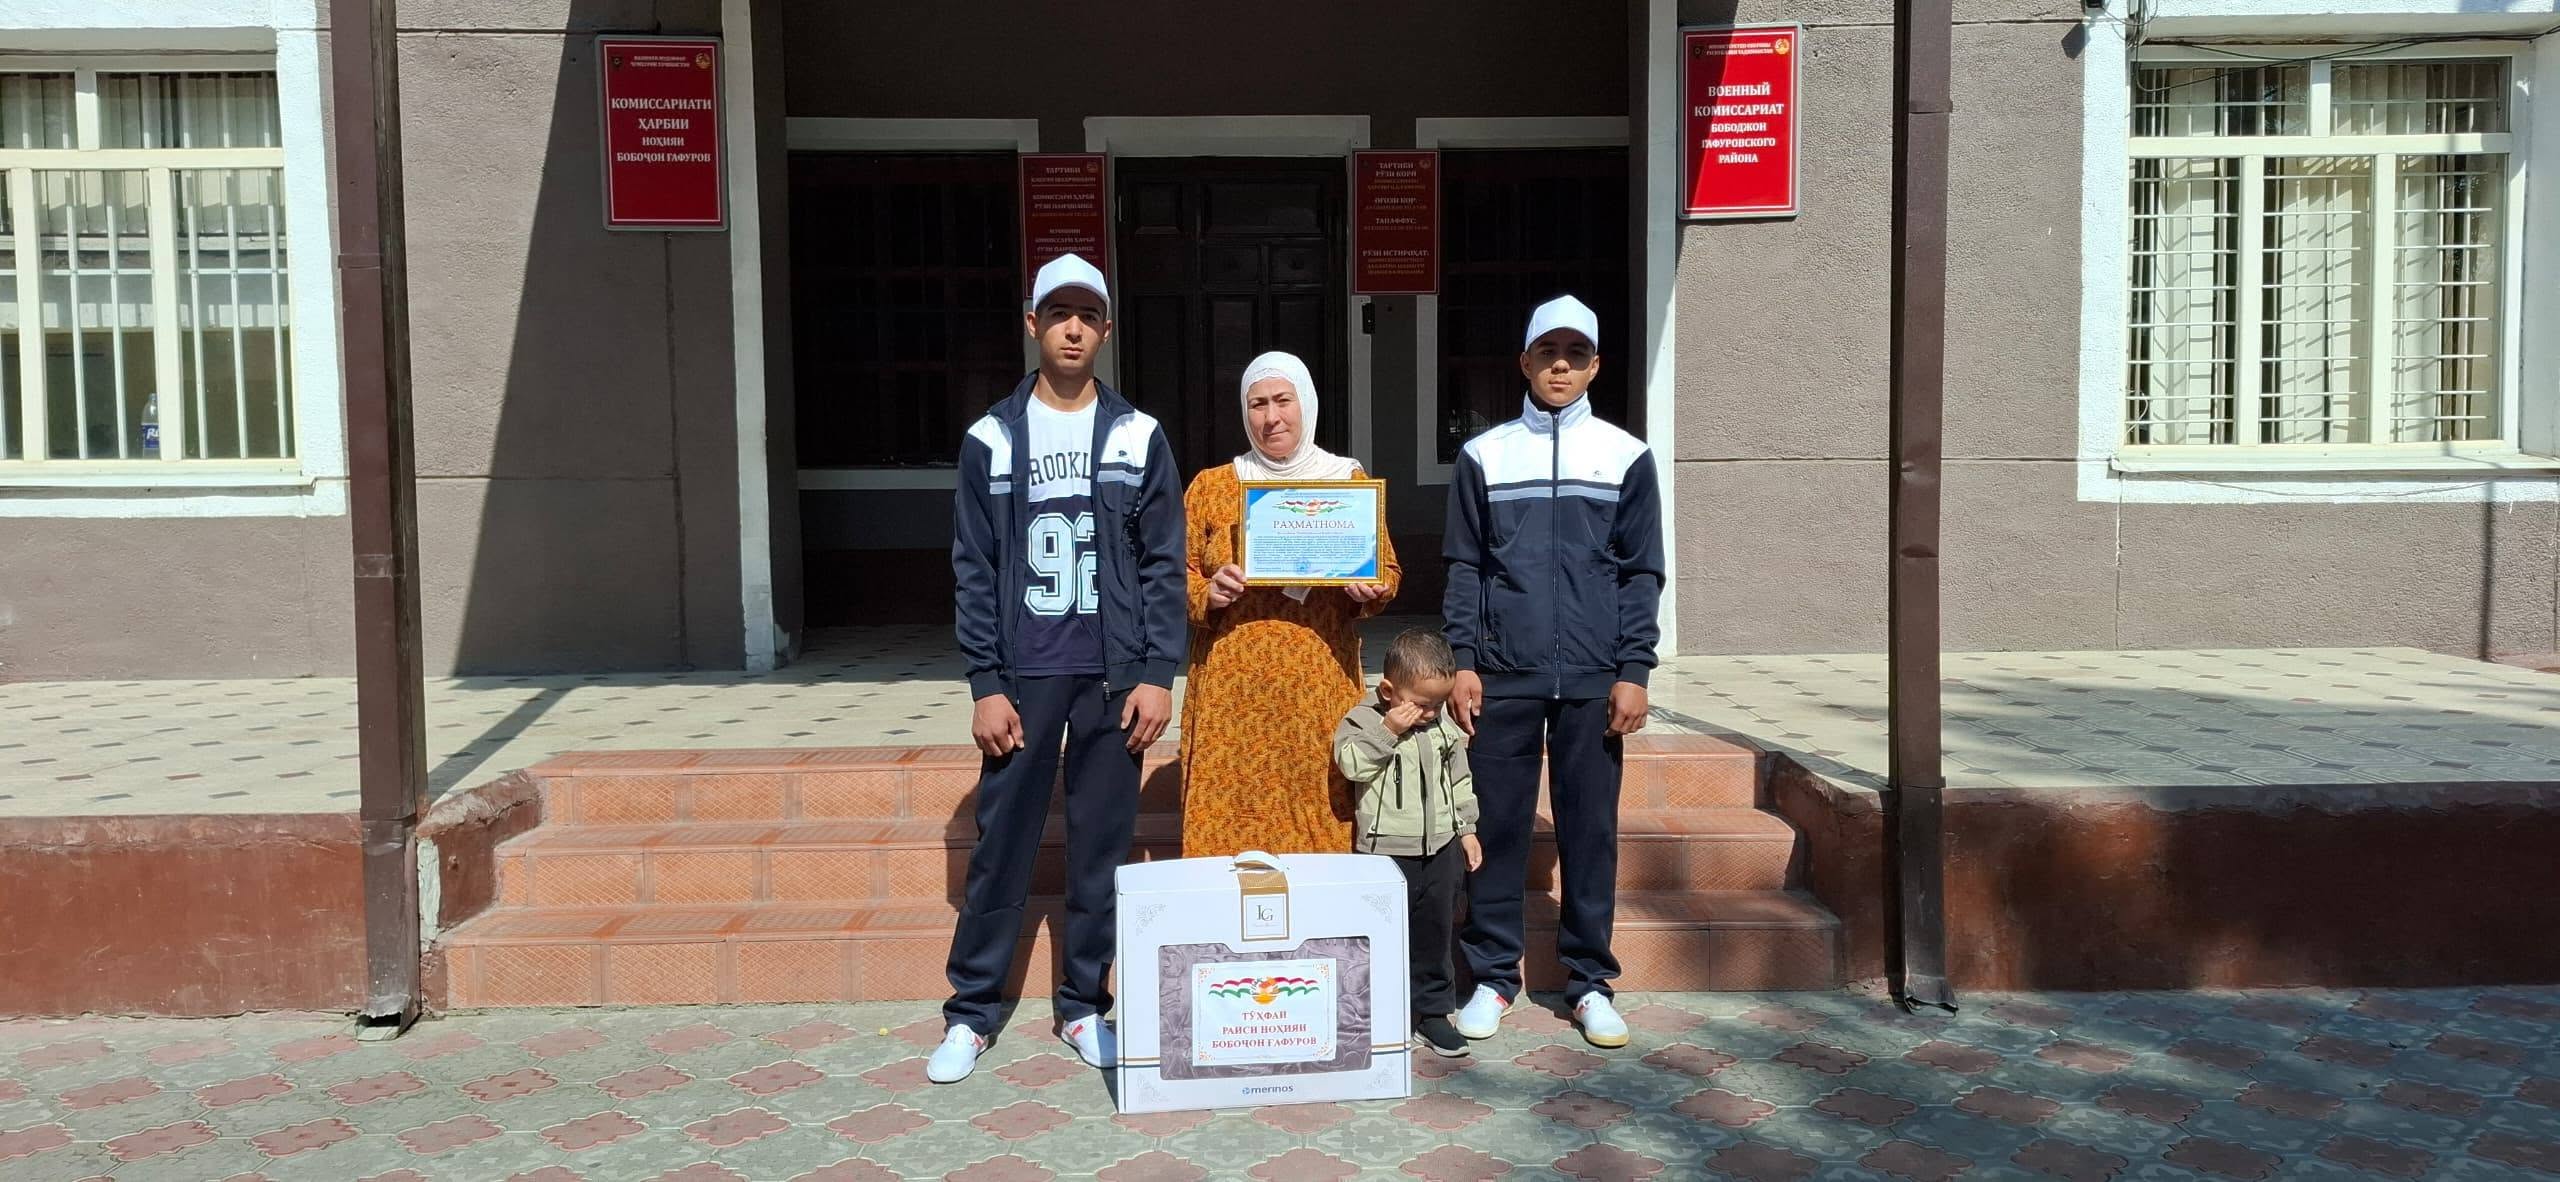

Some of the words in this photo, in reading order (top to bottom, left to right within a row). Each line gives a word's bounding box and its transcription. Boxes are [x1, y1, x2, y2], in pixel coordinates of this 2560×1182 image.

[1708, 82, 1771, 97] ВОЕННЫЙ
[611, 98, 712, 110] КОМИССАРИАТИ
[1694, 103, 1784, 117] КОМИССАРИАТ
[1711, 122, 1767, 134] БОБОДЖОН
[642, 137, 685, 147] НОҲИЯИ
[1702, 137, 1776, 149] ГАФУРОВСКОГО
[1718, 152, 1759, 164] РАЙОНА
[1024, 512, 1100, 616] 92
[1222, 1026, 1258, 1035] РАИСИ
[1261, 1023, 1307, 1034] НОҲИЯИ
[1251, 1085, 1294, 1095] merinos
